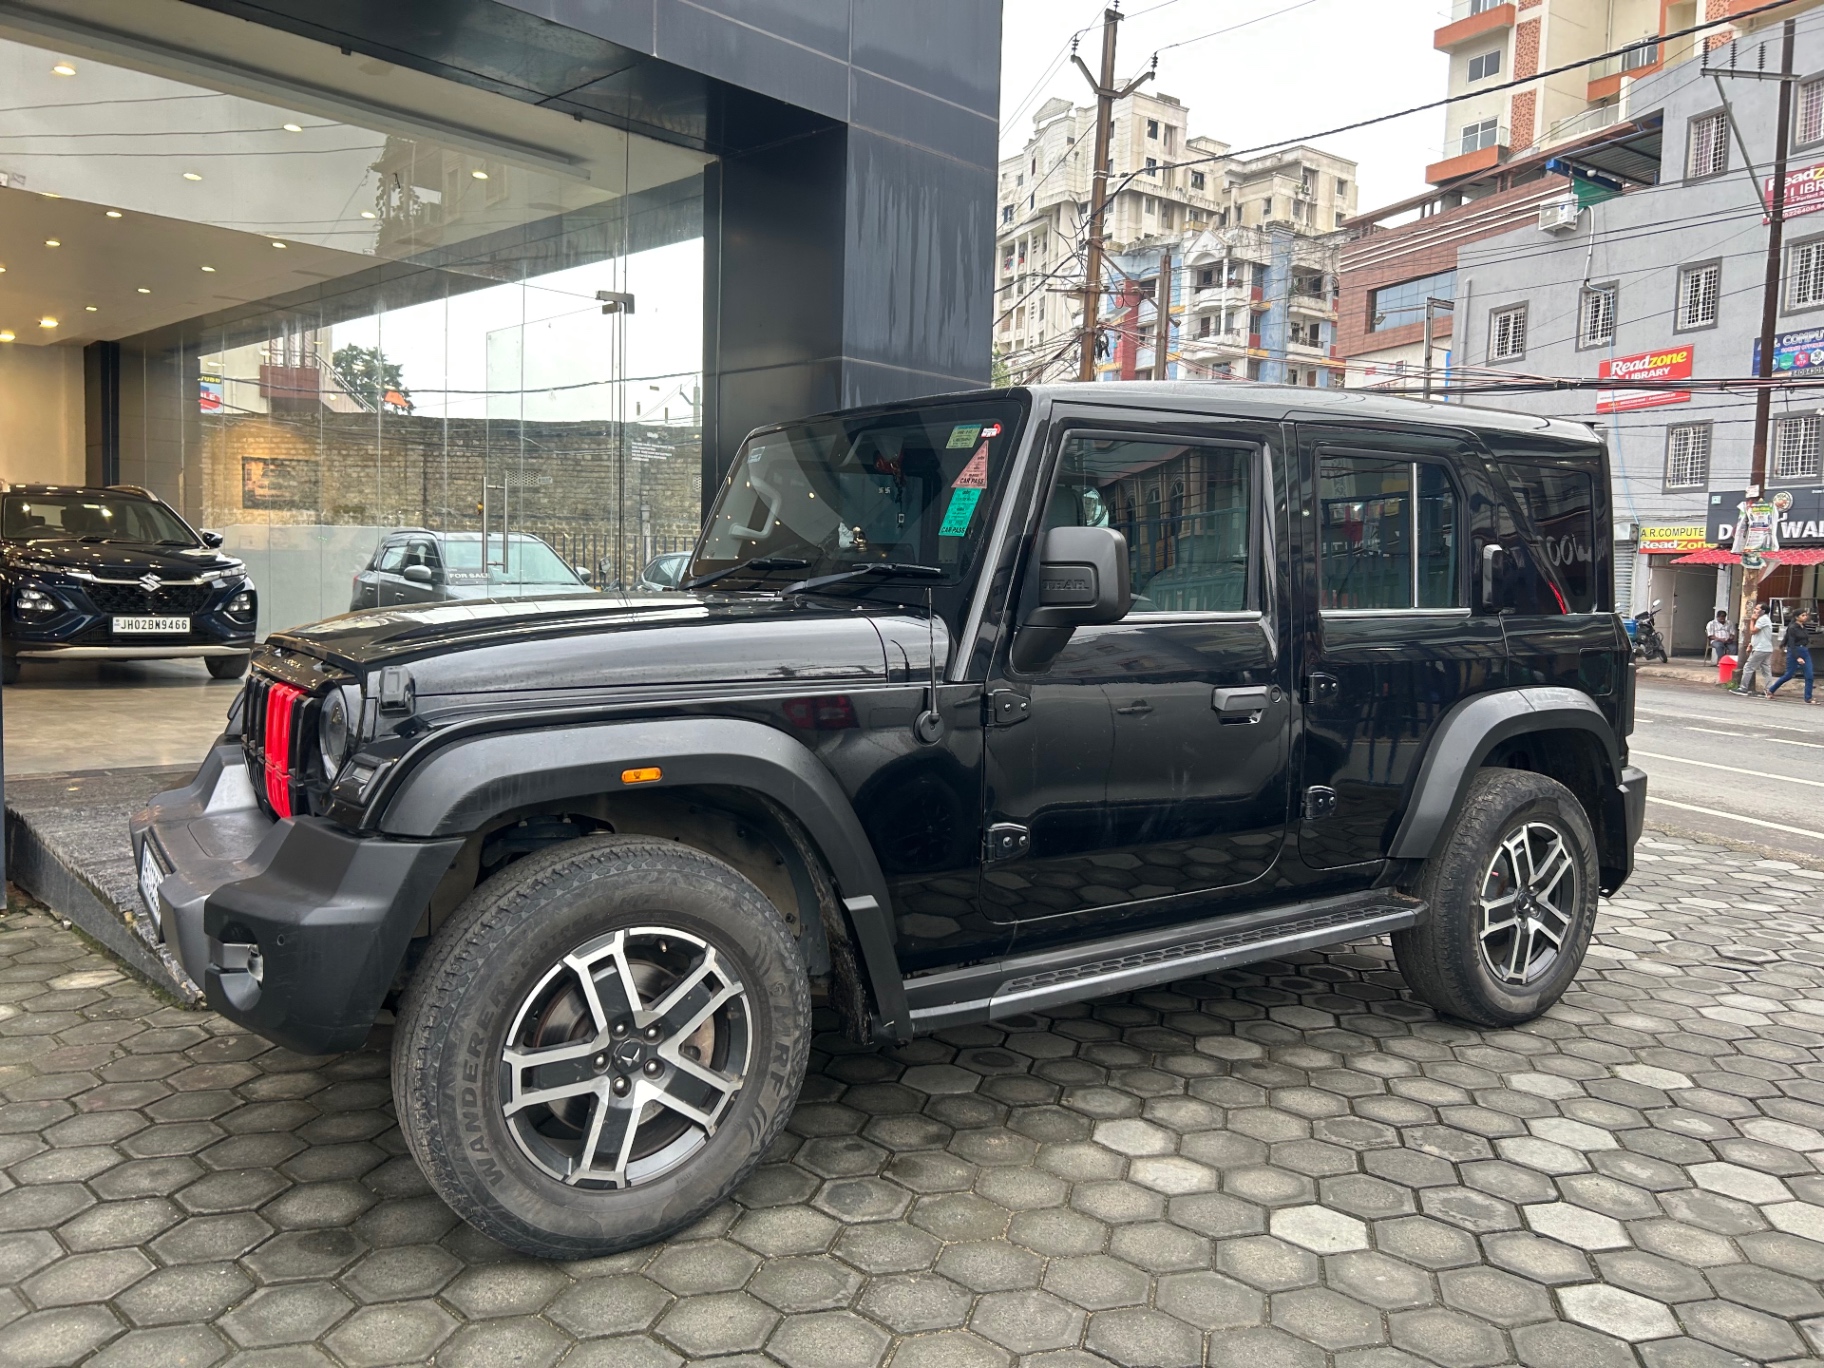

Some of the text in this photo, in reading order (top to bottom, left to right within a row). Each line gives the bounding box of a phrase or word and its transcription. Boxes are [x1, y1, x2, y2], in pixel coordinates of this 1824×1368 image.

[1612, 351, 1687, 375] Readzone
[1625, 366, 1671, 379] LIBRARY
[120, 619, 187, 630] JH02BN9466
[457, 978, 508, 1188] WANDERER
